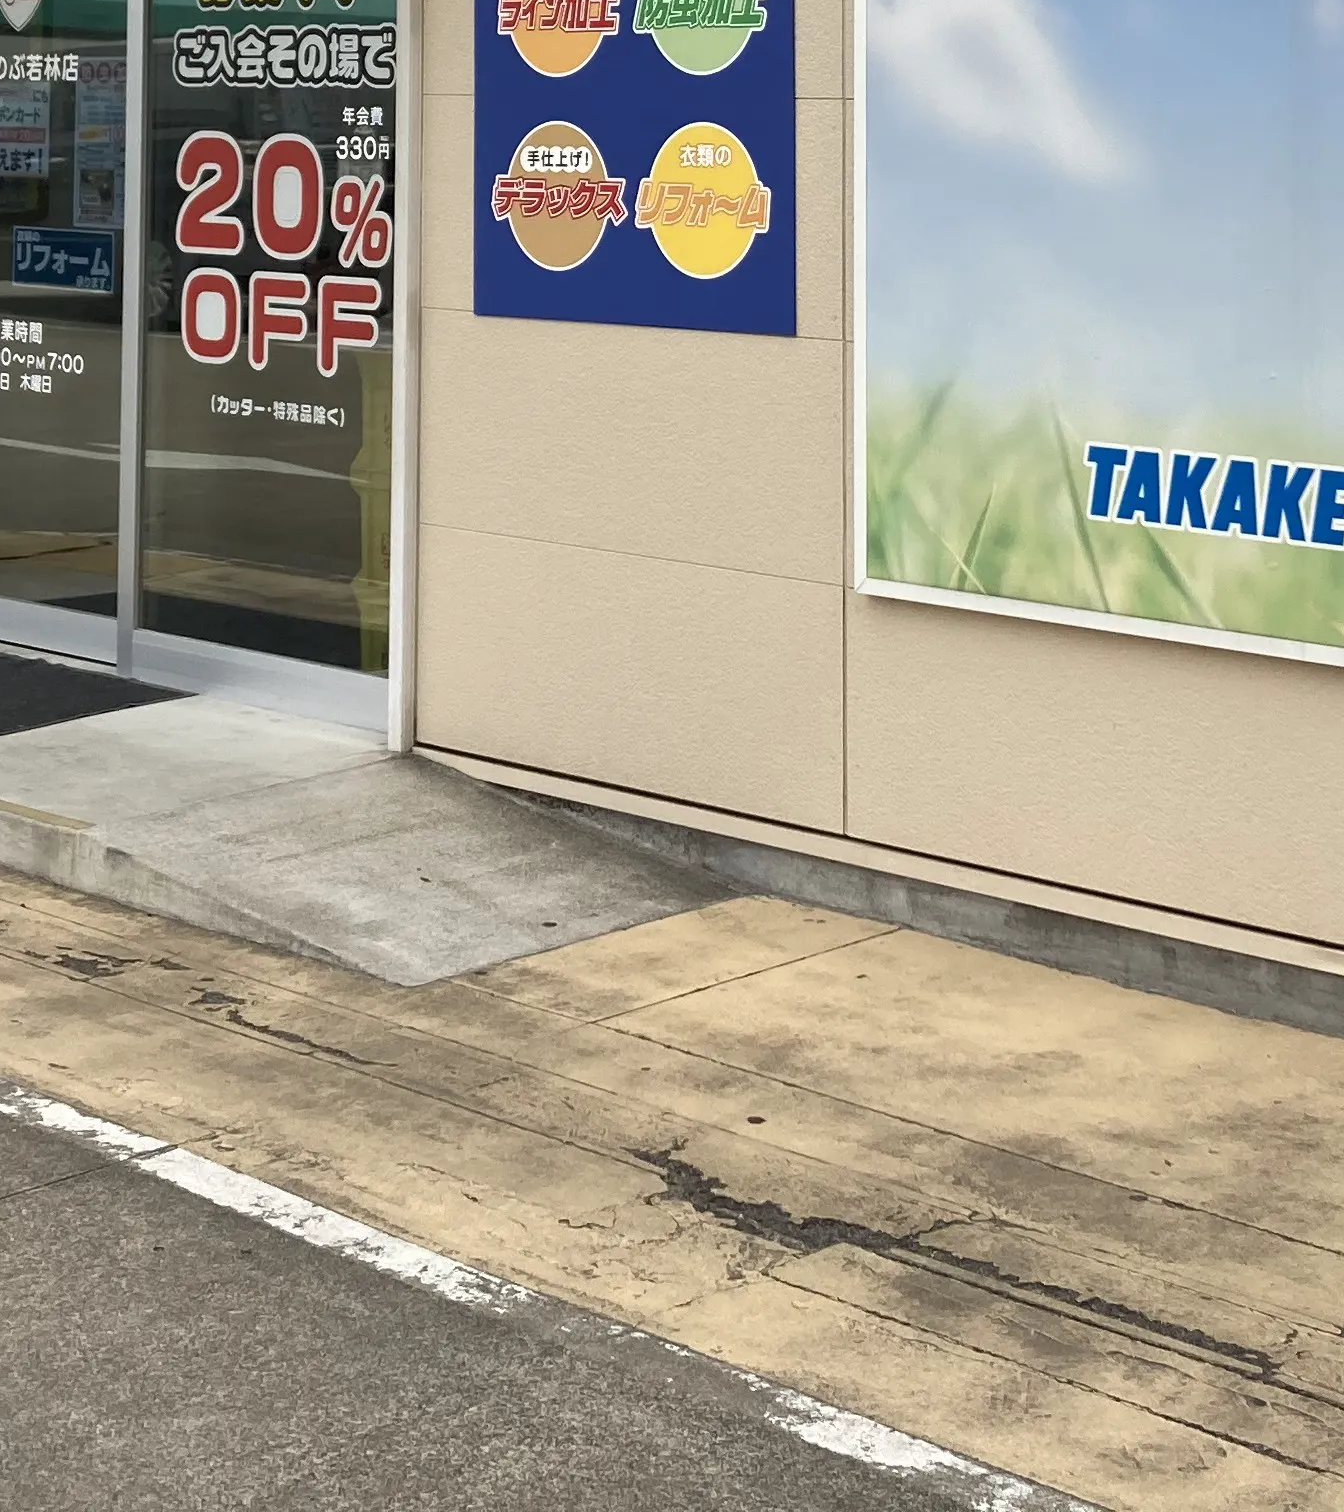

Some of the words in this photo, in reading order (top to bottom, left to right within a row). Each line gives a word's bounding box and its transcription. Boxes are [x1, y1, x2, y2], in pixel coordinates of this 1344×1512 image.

[174, 25, 396, 86] ご入会その場で
[342, 106, 383, 126] 年会費
[336, 135, 390, 160] 330円
[526, 148, 590, 168] 手仕上げ!
[679, 143, 732, 168] 衣類の
[176, 130, 392, 267] 20%
[494, 177, 626, 222] デラックス
[16, 242, 110, 277] リフォーム
[182, 267, 382, 377] OFF
[19, 373, 52, 393] 木曜日
